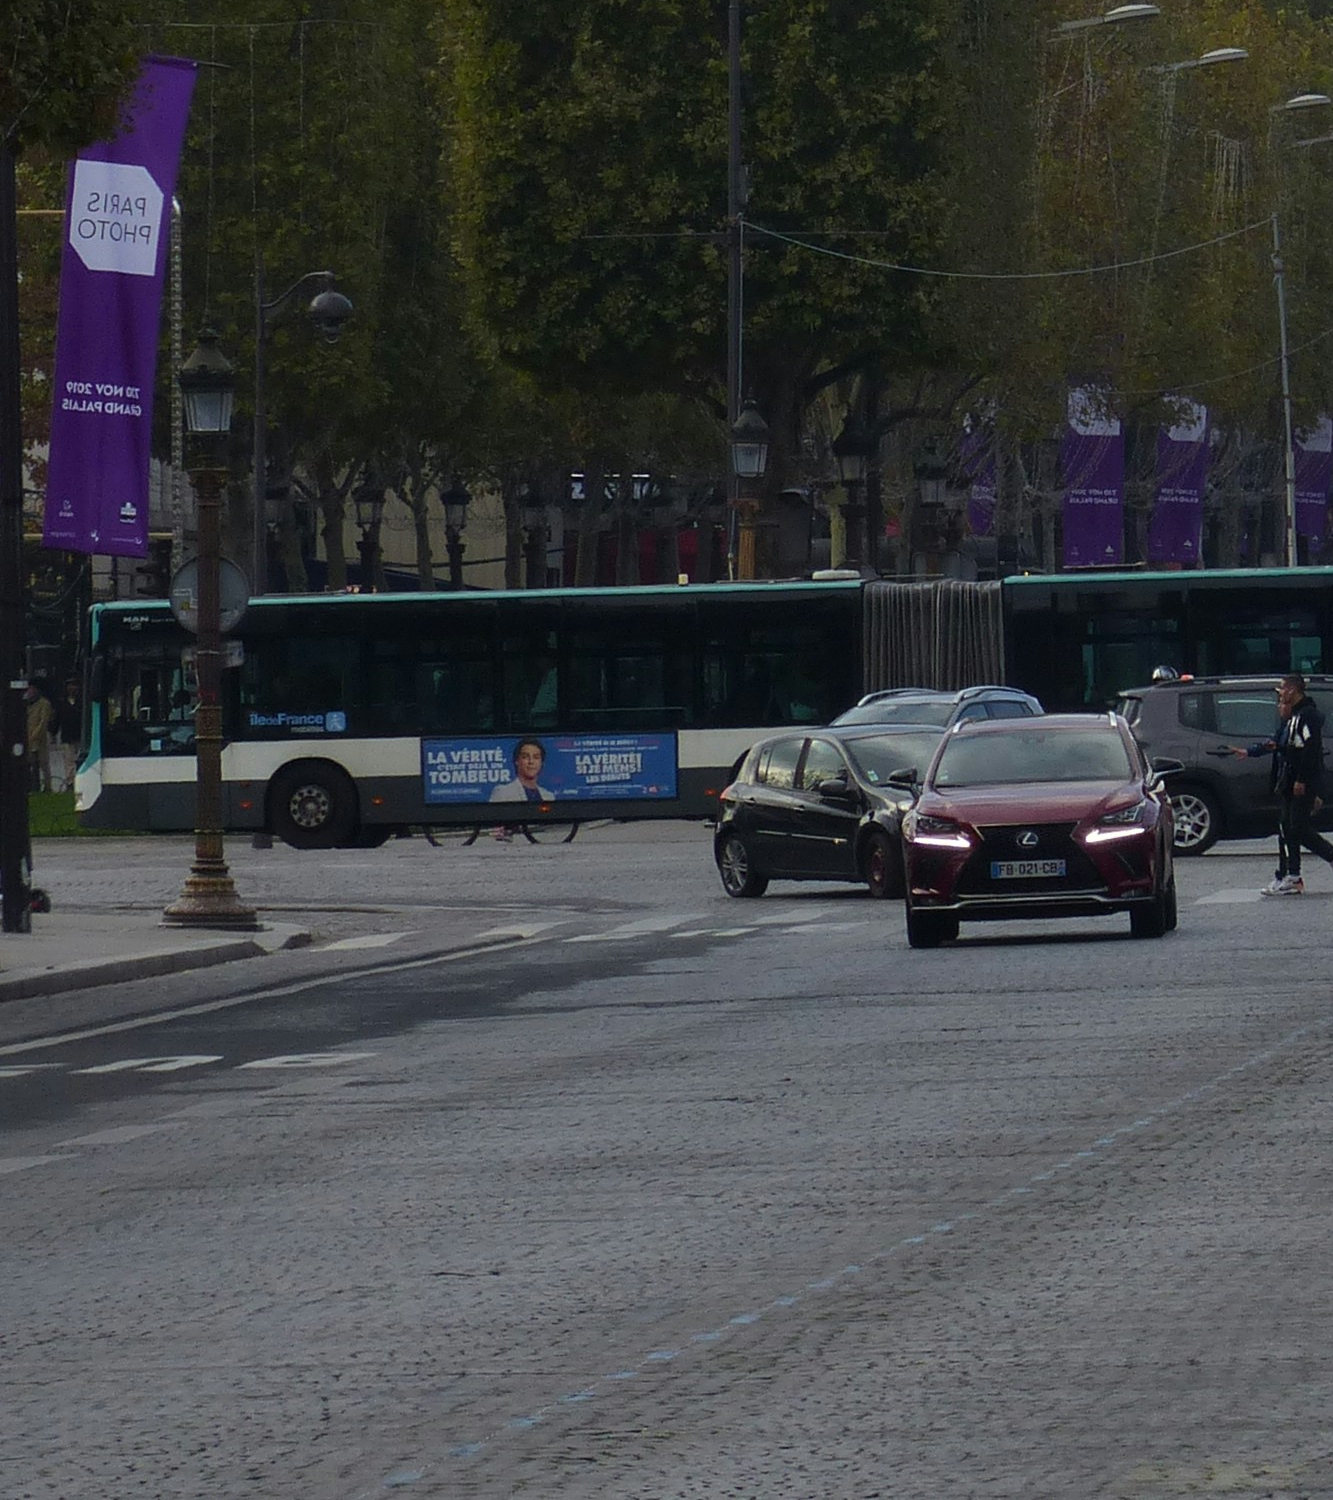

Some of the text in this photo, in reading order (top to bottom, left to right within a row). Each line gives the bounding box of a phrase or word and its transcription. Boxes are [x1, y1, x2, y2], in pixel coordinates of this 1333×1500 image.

[427, 751, 447, 764] LA
[575, 754, 592, 765] LA
[588, 764, 601, 773] JE
[429, 769, 511, 784] TOMBEUR
